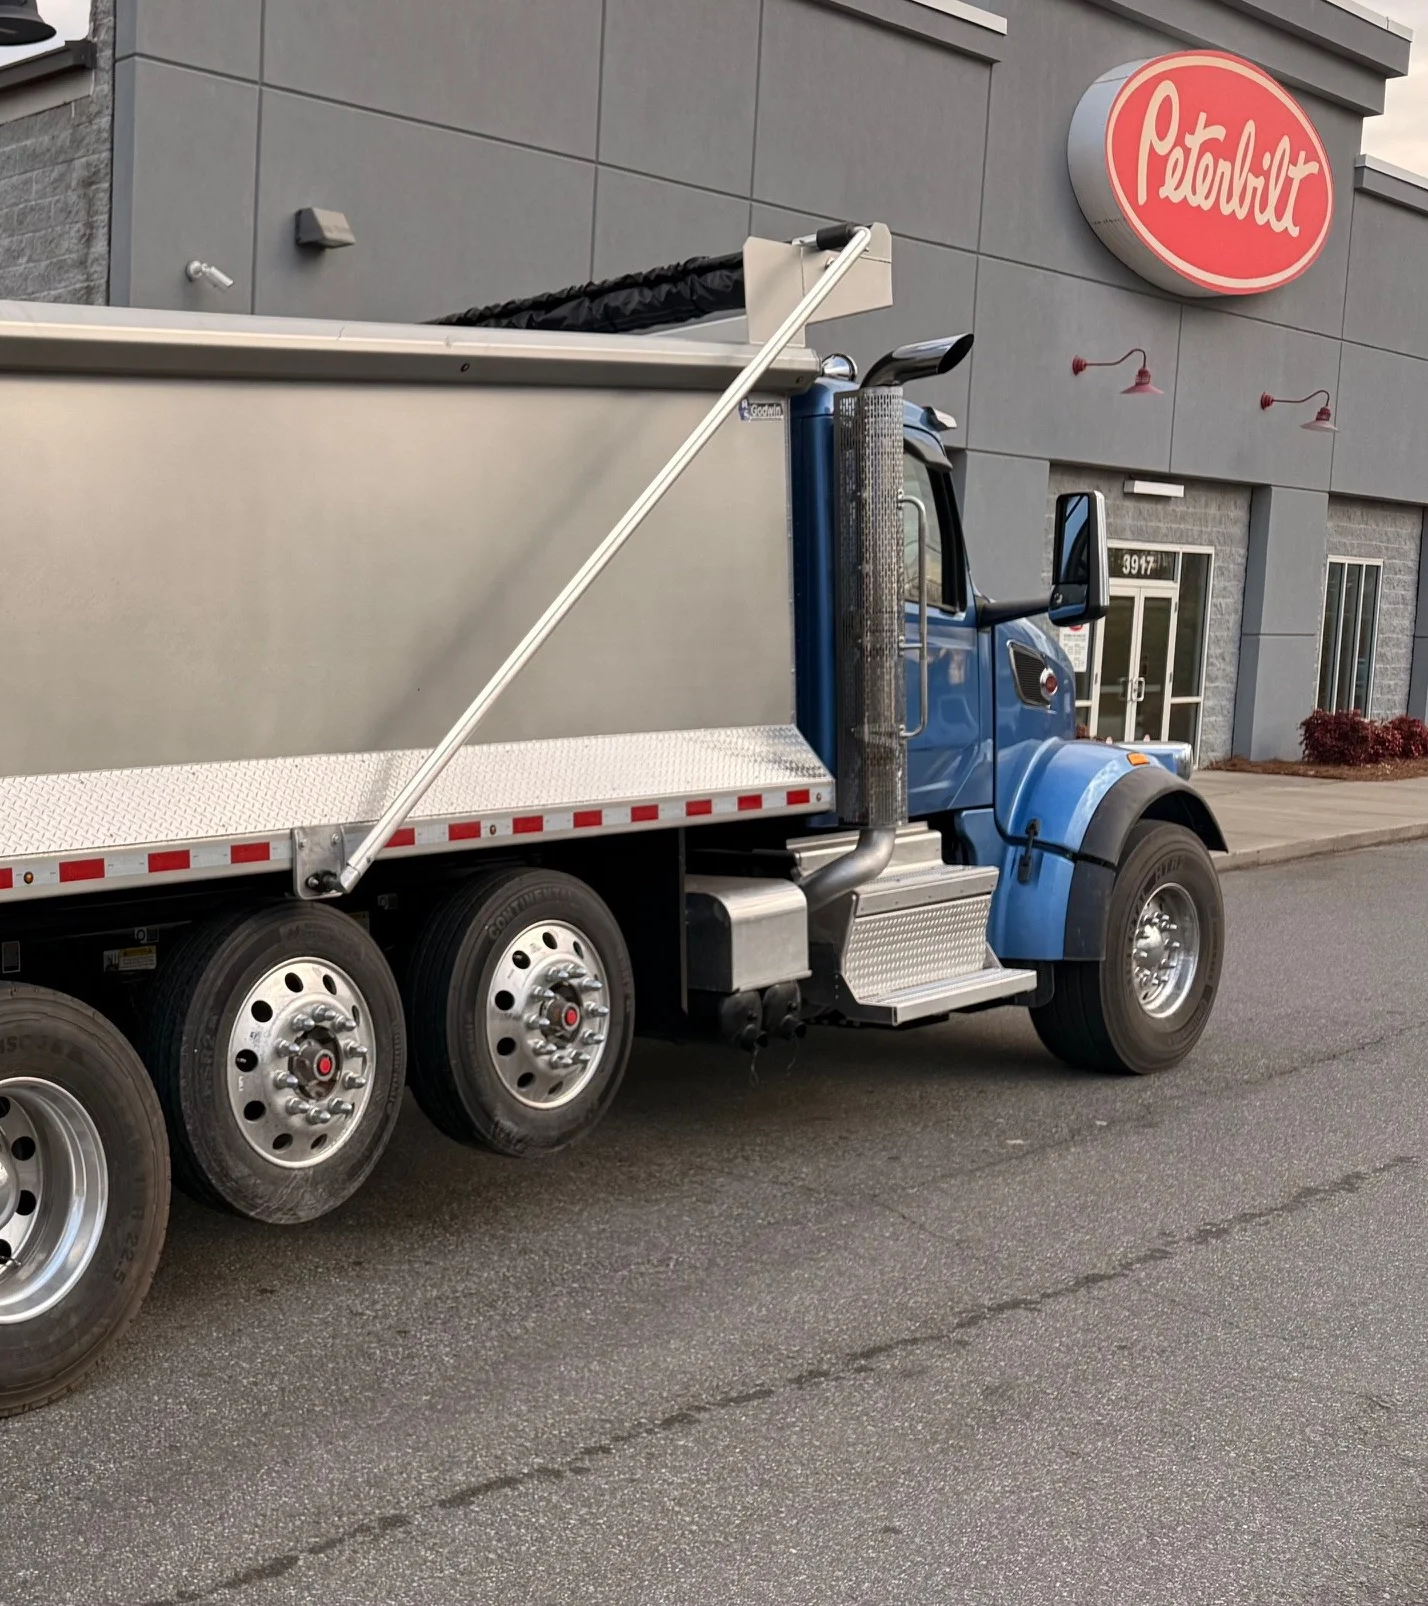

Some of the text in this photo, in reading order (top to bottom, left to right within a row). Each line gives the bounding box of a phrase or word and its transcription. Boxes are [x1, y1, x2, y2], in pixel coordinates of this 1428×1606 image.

[1137, 79, 1320, 238] Peterbilt
[751, 403, 781, 417] Godwin
[1122, 554, 1155, 576] 3917
